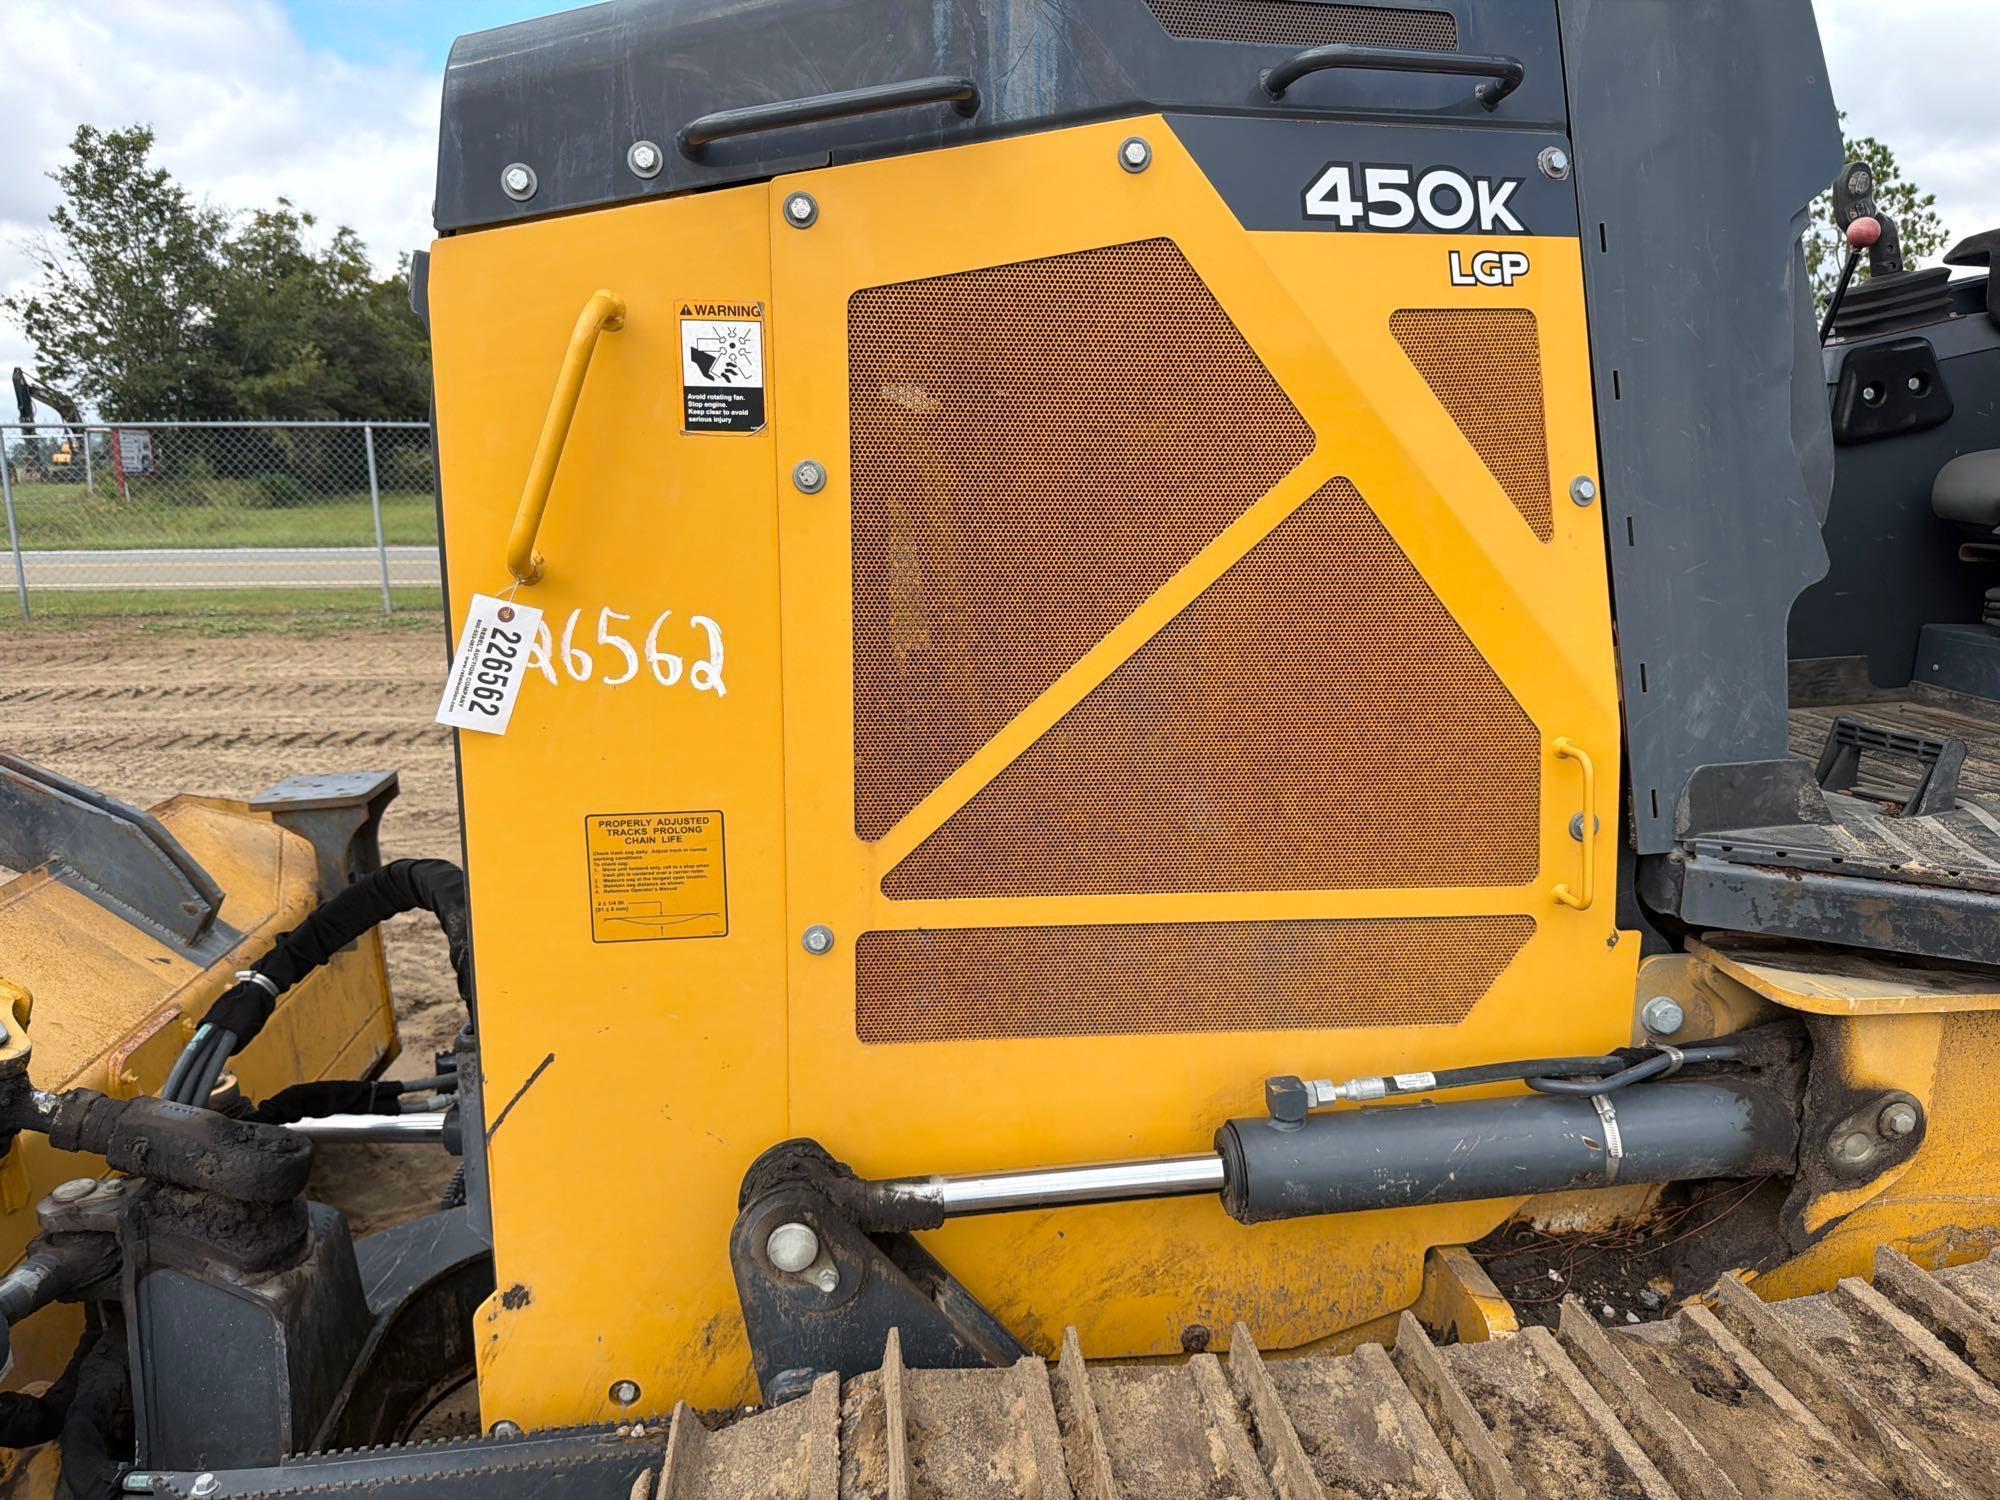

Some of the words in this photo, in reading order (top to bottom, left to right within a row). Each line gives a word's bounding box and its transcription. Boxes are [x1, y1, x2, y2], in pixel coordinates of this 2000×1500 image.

[1303, 165, 1527, 233] 450K
[1448, 250, 1530, 287] LGP
[694, 304, 761, 317] WARNING
[479, 628, 488, 646] REBEL
[467, 649, 481, 676] AUCTION
[468, 627, 522, 716] 226562
[459, 677, 472, 707] COMPANY
[598, 819, 652, 828] PROPERLY
[657, 817, 709, 826] ADJUSTED
[607, 828, 648, 836] TRACKS
[653, 826, 702, 834] PROLONG
